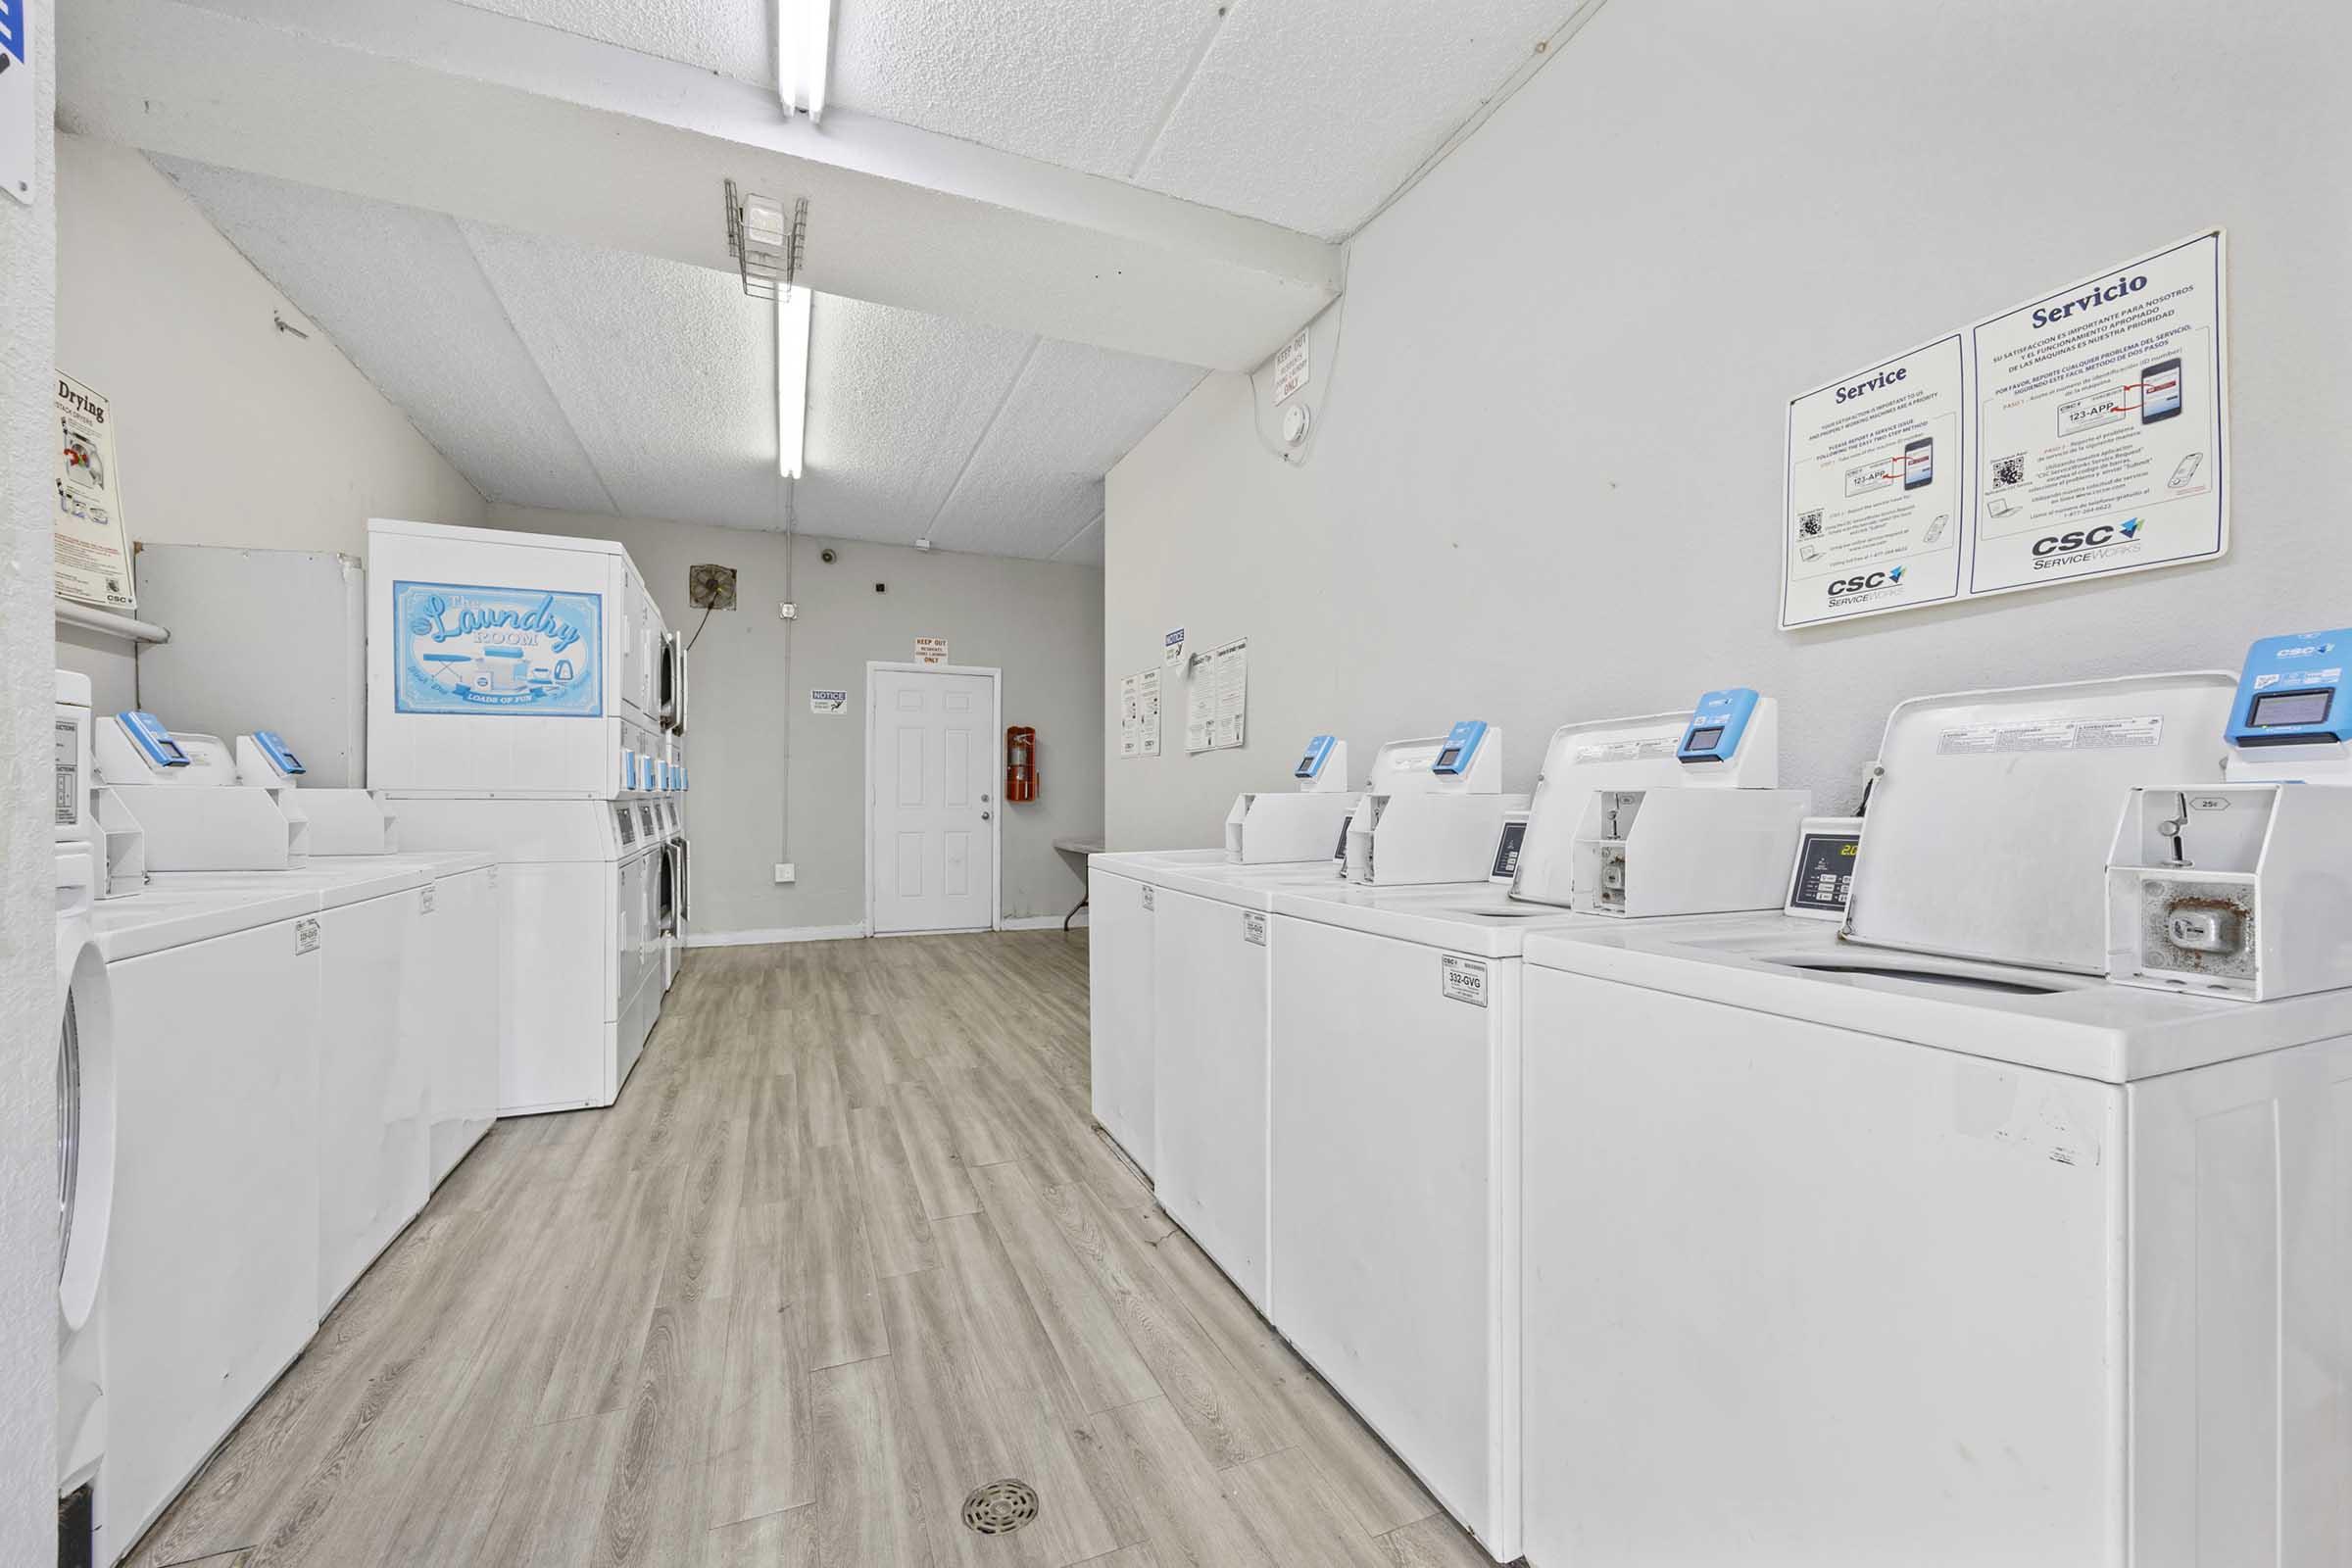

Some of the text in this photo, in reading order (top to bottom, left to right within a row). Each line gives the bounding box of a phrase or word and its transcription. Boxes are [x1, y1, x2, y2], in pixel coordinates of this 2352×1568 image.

[2032, 275, 2147, 329] Servicio
[2068, 312, 2118, 335] IMPORTANTE
[2121, 303, 2143, 316] PARA
[2145, 284, 2193, 307] NOSOTROS
[2008, 364, 2018, 372] DE
[2019, 359, 2033, 368] LAS
[2077, 340, 2086, 349] ES
[2088, 326, 2125, 344] NUESTRA
[2127, 309, 2175, 330] PRIORIDAD
[2036, 324, 2107, 354] FUNCIONAMIENTO
[2109, 306, 2159, 328] APROPIADO
[2033, 369, 2059, 382] REPORTE
[2061, 356, 2099, 372] CUALQUIER
[2100, 342, 2138, 360] PROBLEMA
[2140, 336, 2153, 346] DEL
[1836, 368, 1907, 405] Service
[59, 380, 104, 423] Drying
[1876, 396, 1905, 411] IMPORTANT
[2069, 402, 2114, 421] 123-APP
[1853, 469, 1886, 486] 123-APP
[2032, 525, 2114, 556] CSC
[1828, 572, 1886, 596] CSC
[431, 595, 581, 654] Laundry
[473, 632, 539, 647] ROOM
[1166, 630, 1184, 645] NOTICE
[2277, 647, 2315, 658] CSC
[500, 696, 513, 705] OF
[814, 691, 845, 700] NOTICE
[1449, 972, 1481, 988] 332-GVG
